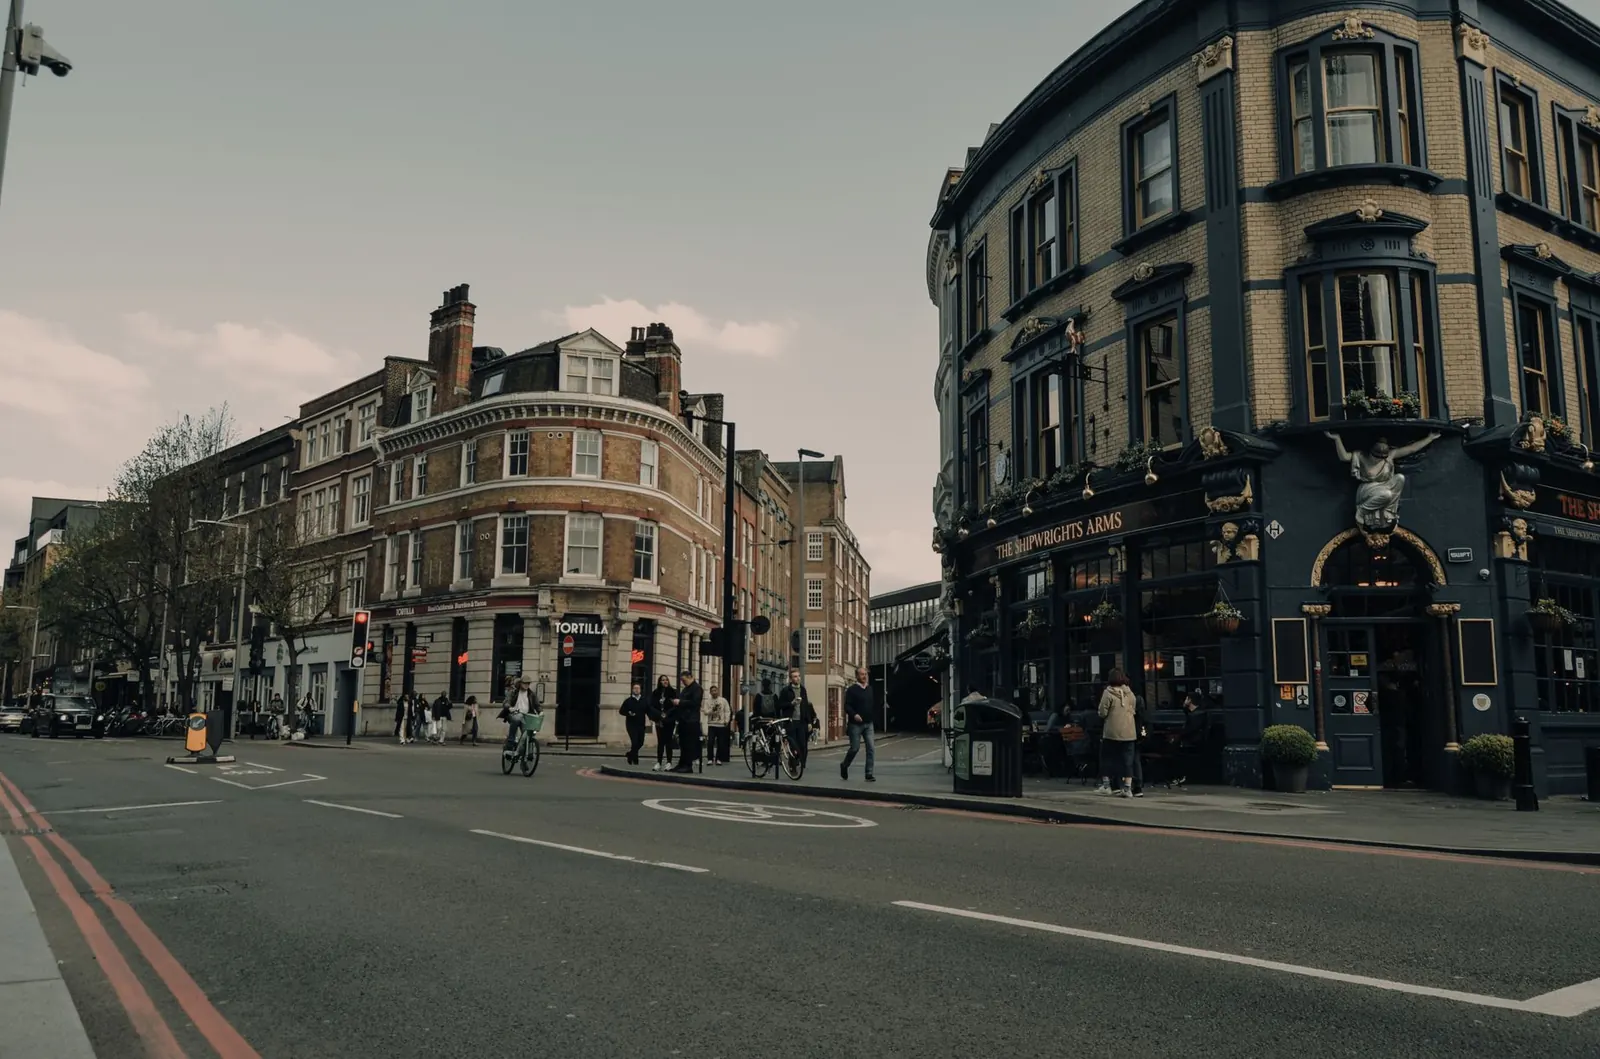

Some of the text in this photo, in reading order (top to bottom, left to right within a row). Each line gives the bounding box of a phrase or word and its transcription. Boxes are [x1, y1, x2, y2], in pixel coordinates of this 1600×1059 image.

[1559, 496, 1585, 518] THE
[997, 511, 1123, 559] THE SHIPWRIGHTS ARMS
[555, 621, 609, 635] TORTILLA
